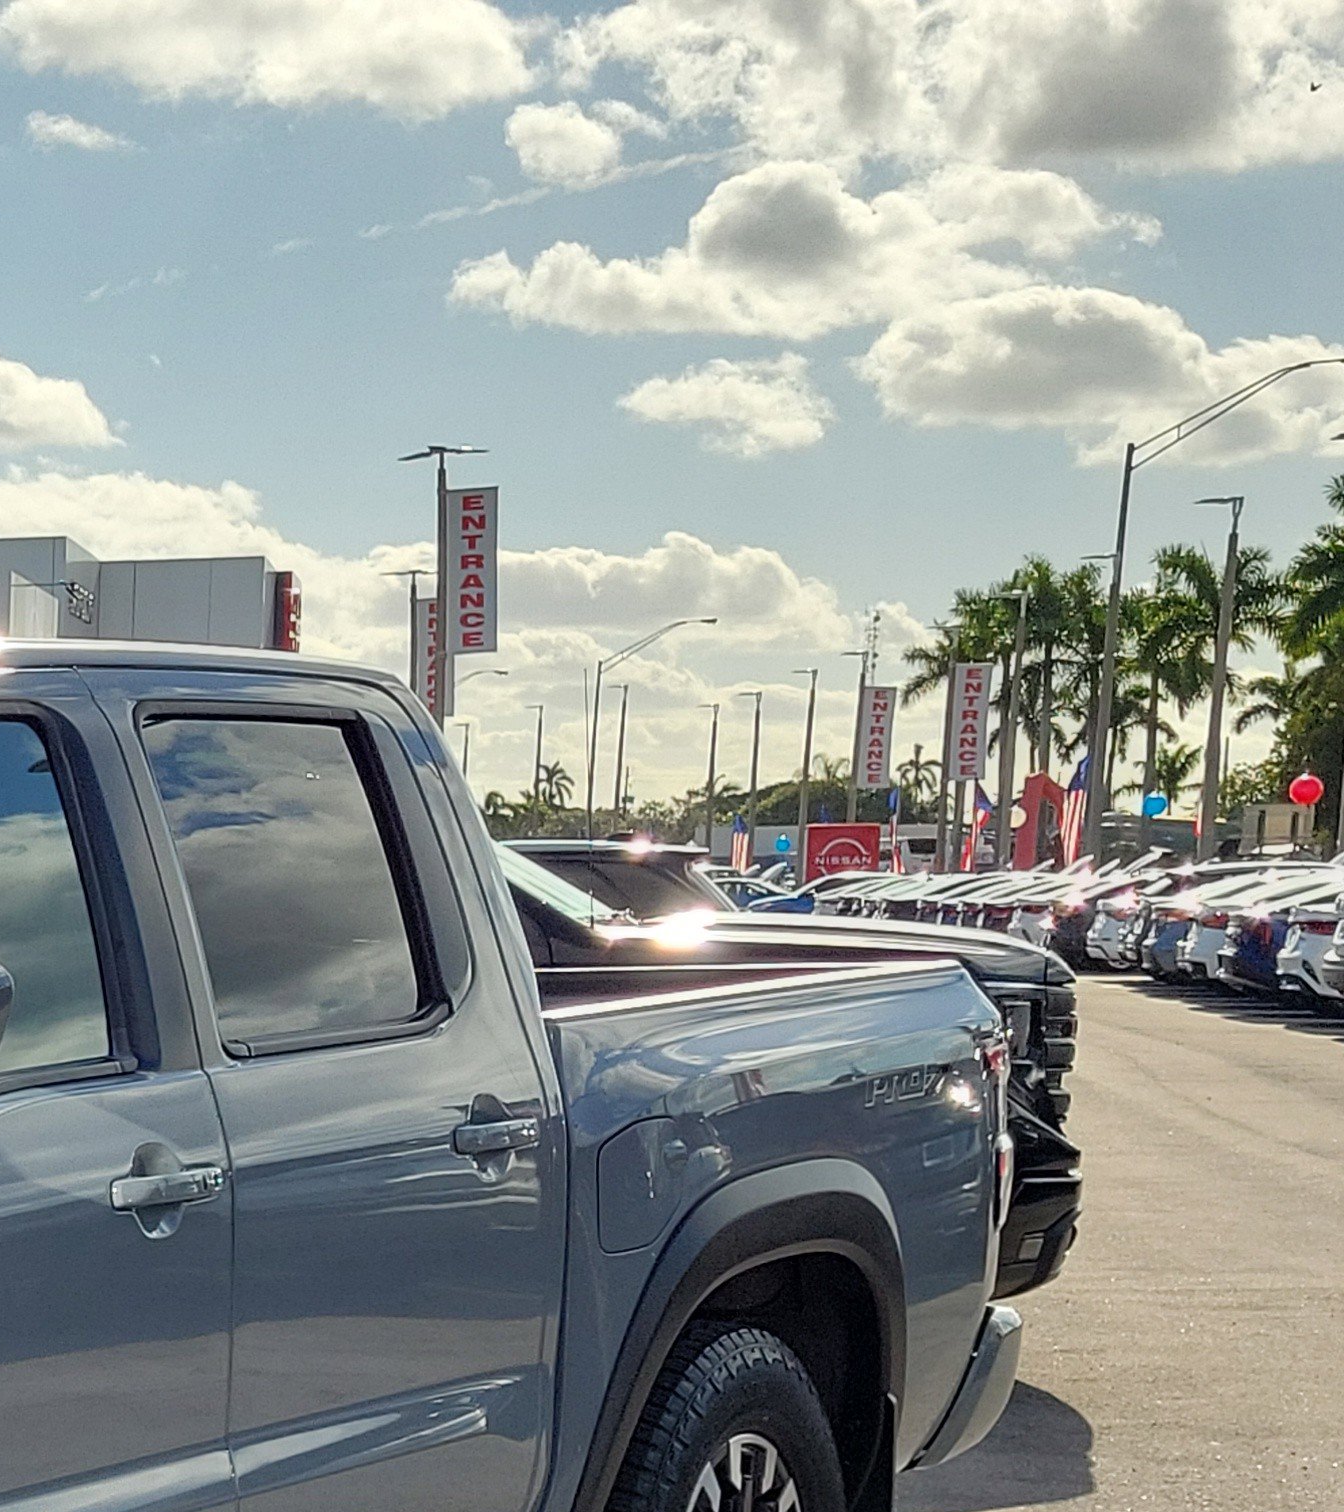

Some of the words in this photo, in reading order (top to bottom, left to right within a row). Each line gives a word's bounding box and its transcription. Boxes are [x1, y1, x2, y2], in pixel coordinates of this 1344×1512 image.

[460, 495, 486, 647] ENTRANCE
[866, 690, 889, 784] ENTRANCE
[958, 668, 983, 776] ENTRANCE
[814, 856, 872, 865] NISSAN
